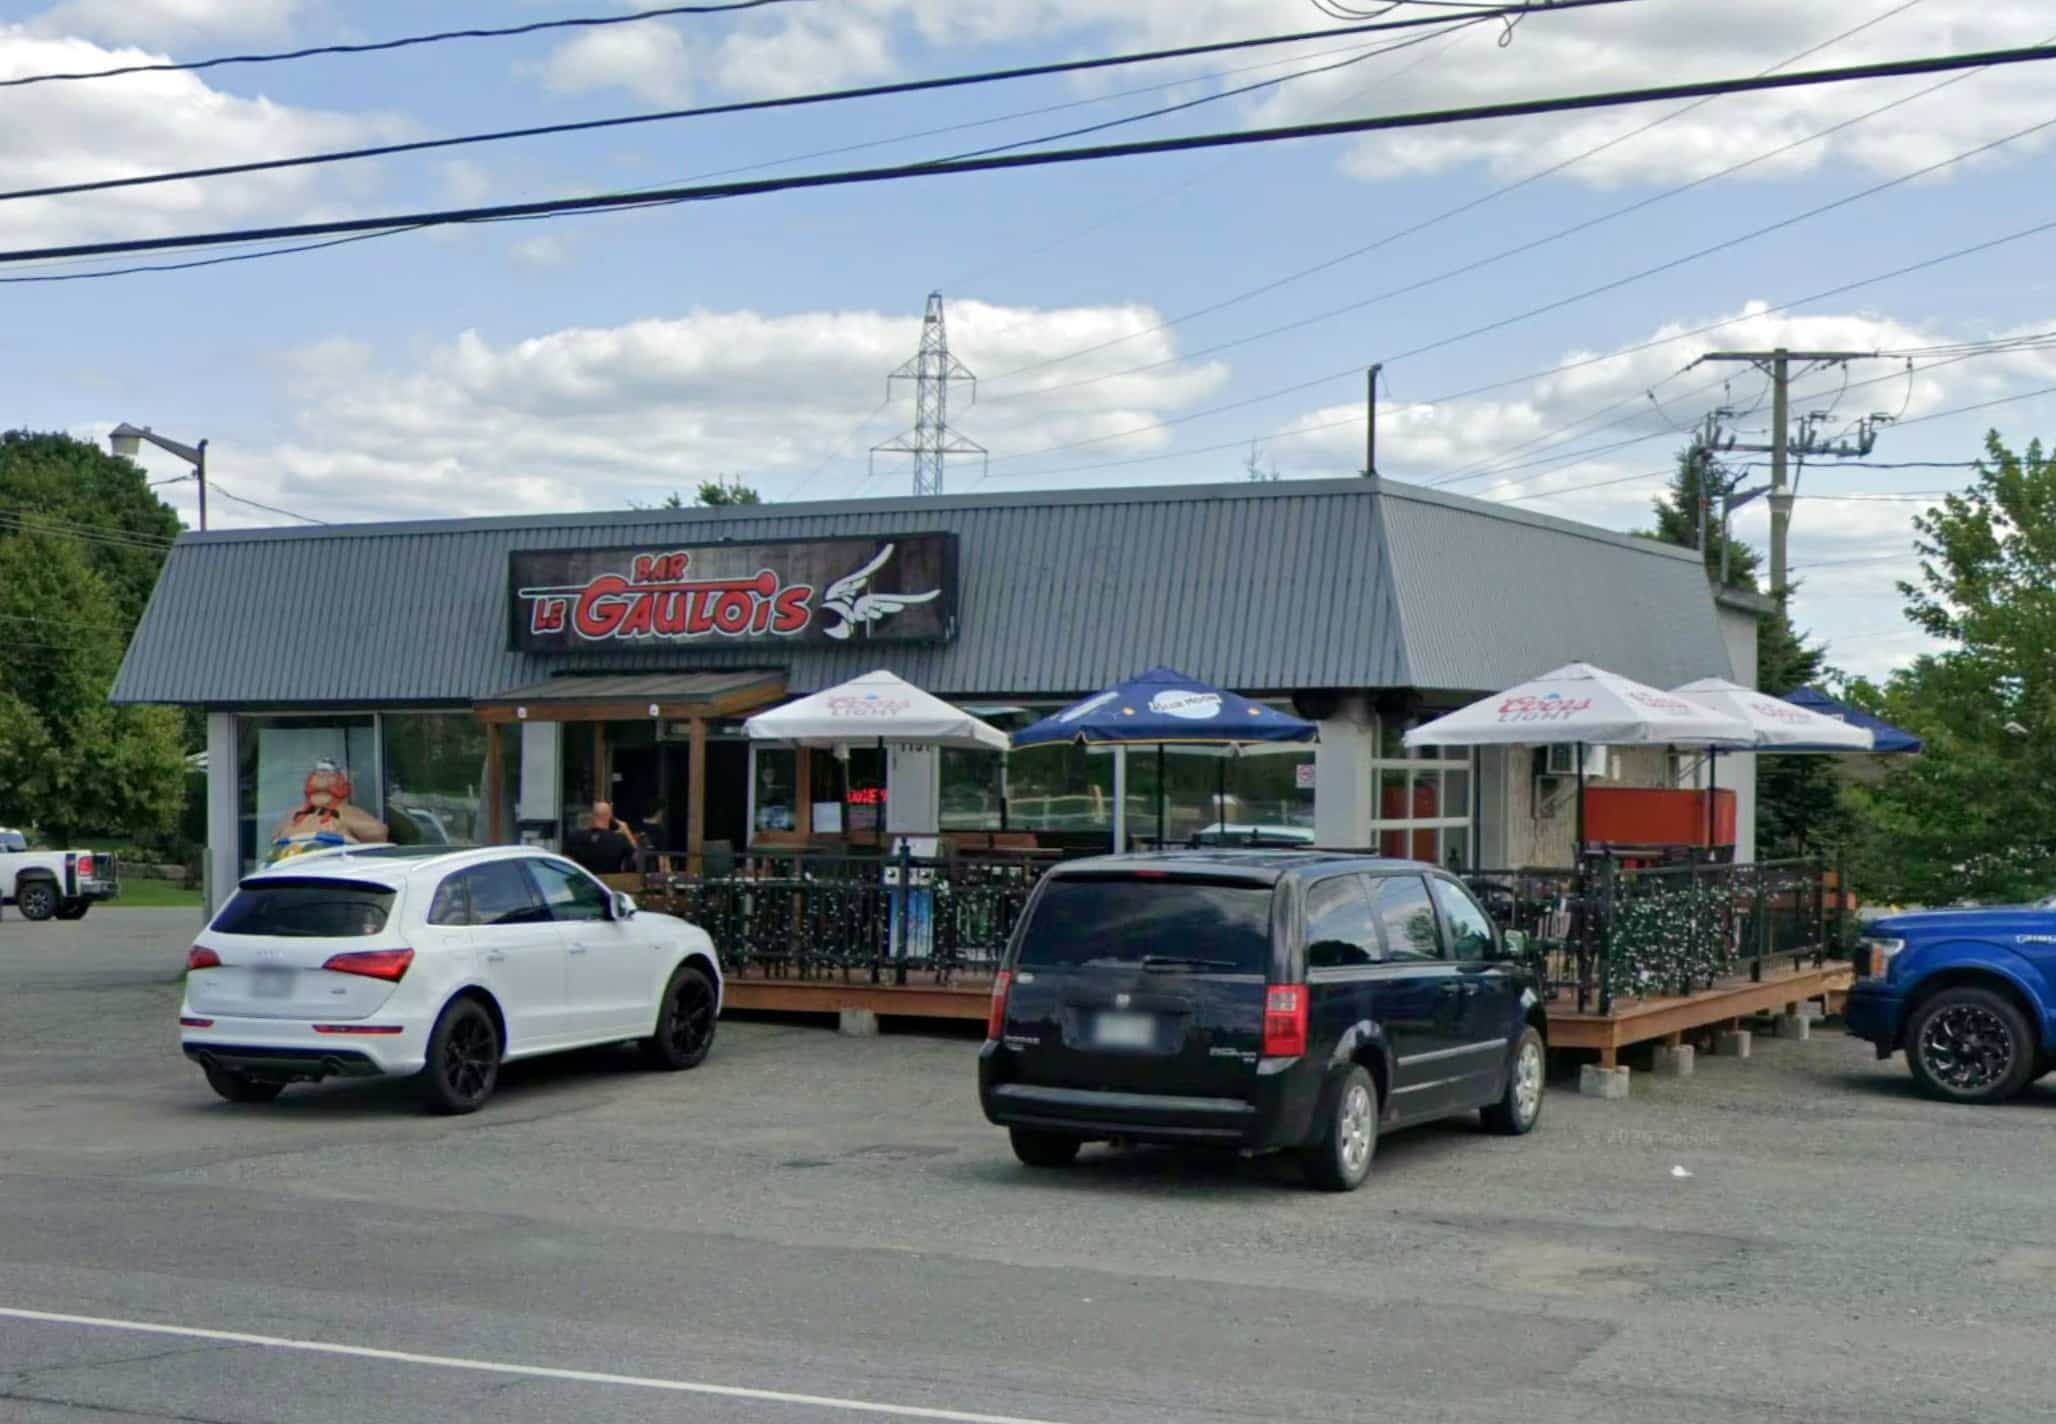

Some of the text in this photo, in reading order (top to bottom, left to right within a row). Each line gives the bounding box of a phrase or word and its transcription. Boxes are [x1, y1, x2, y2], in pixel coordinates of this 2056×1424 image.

[633, 552, 689, 582] BAR
[532, 598, 566, 633] LE
[1497, 711, 1575, 722] LIGHT
